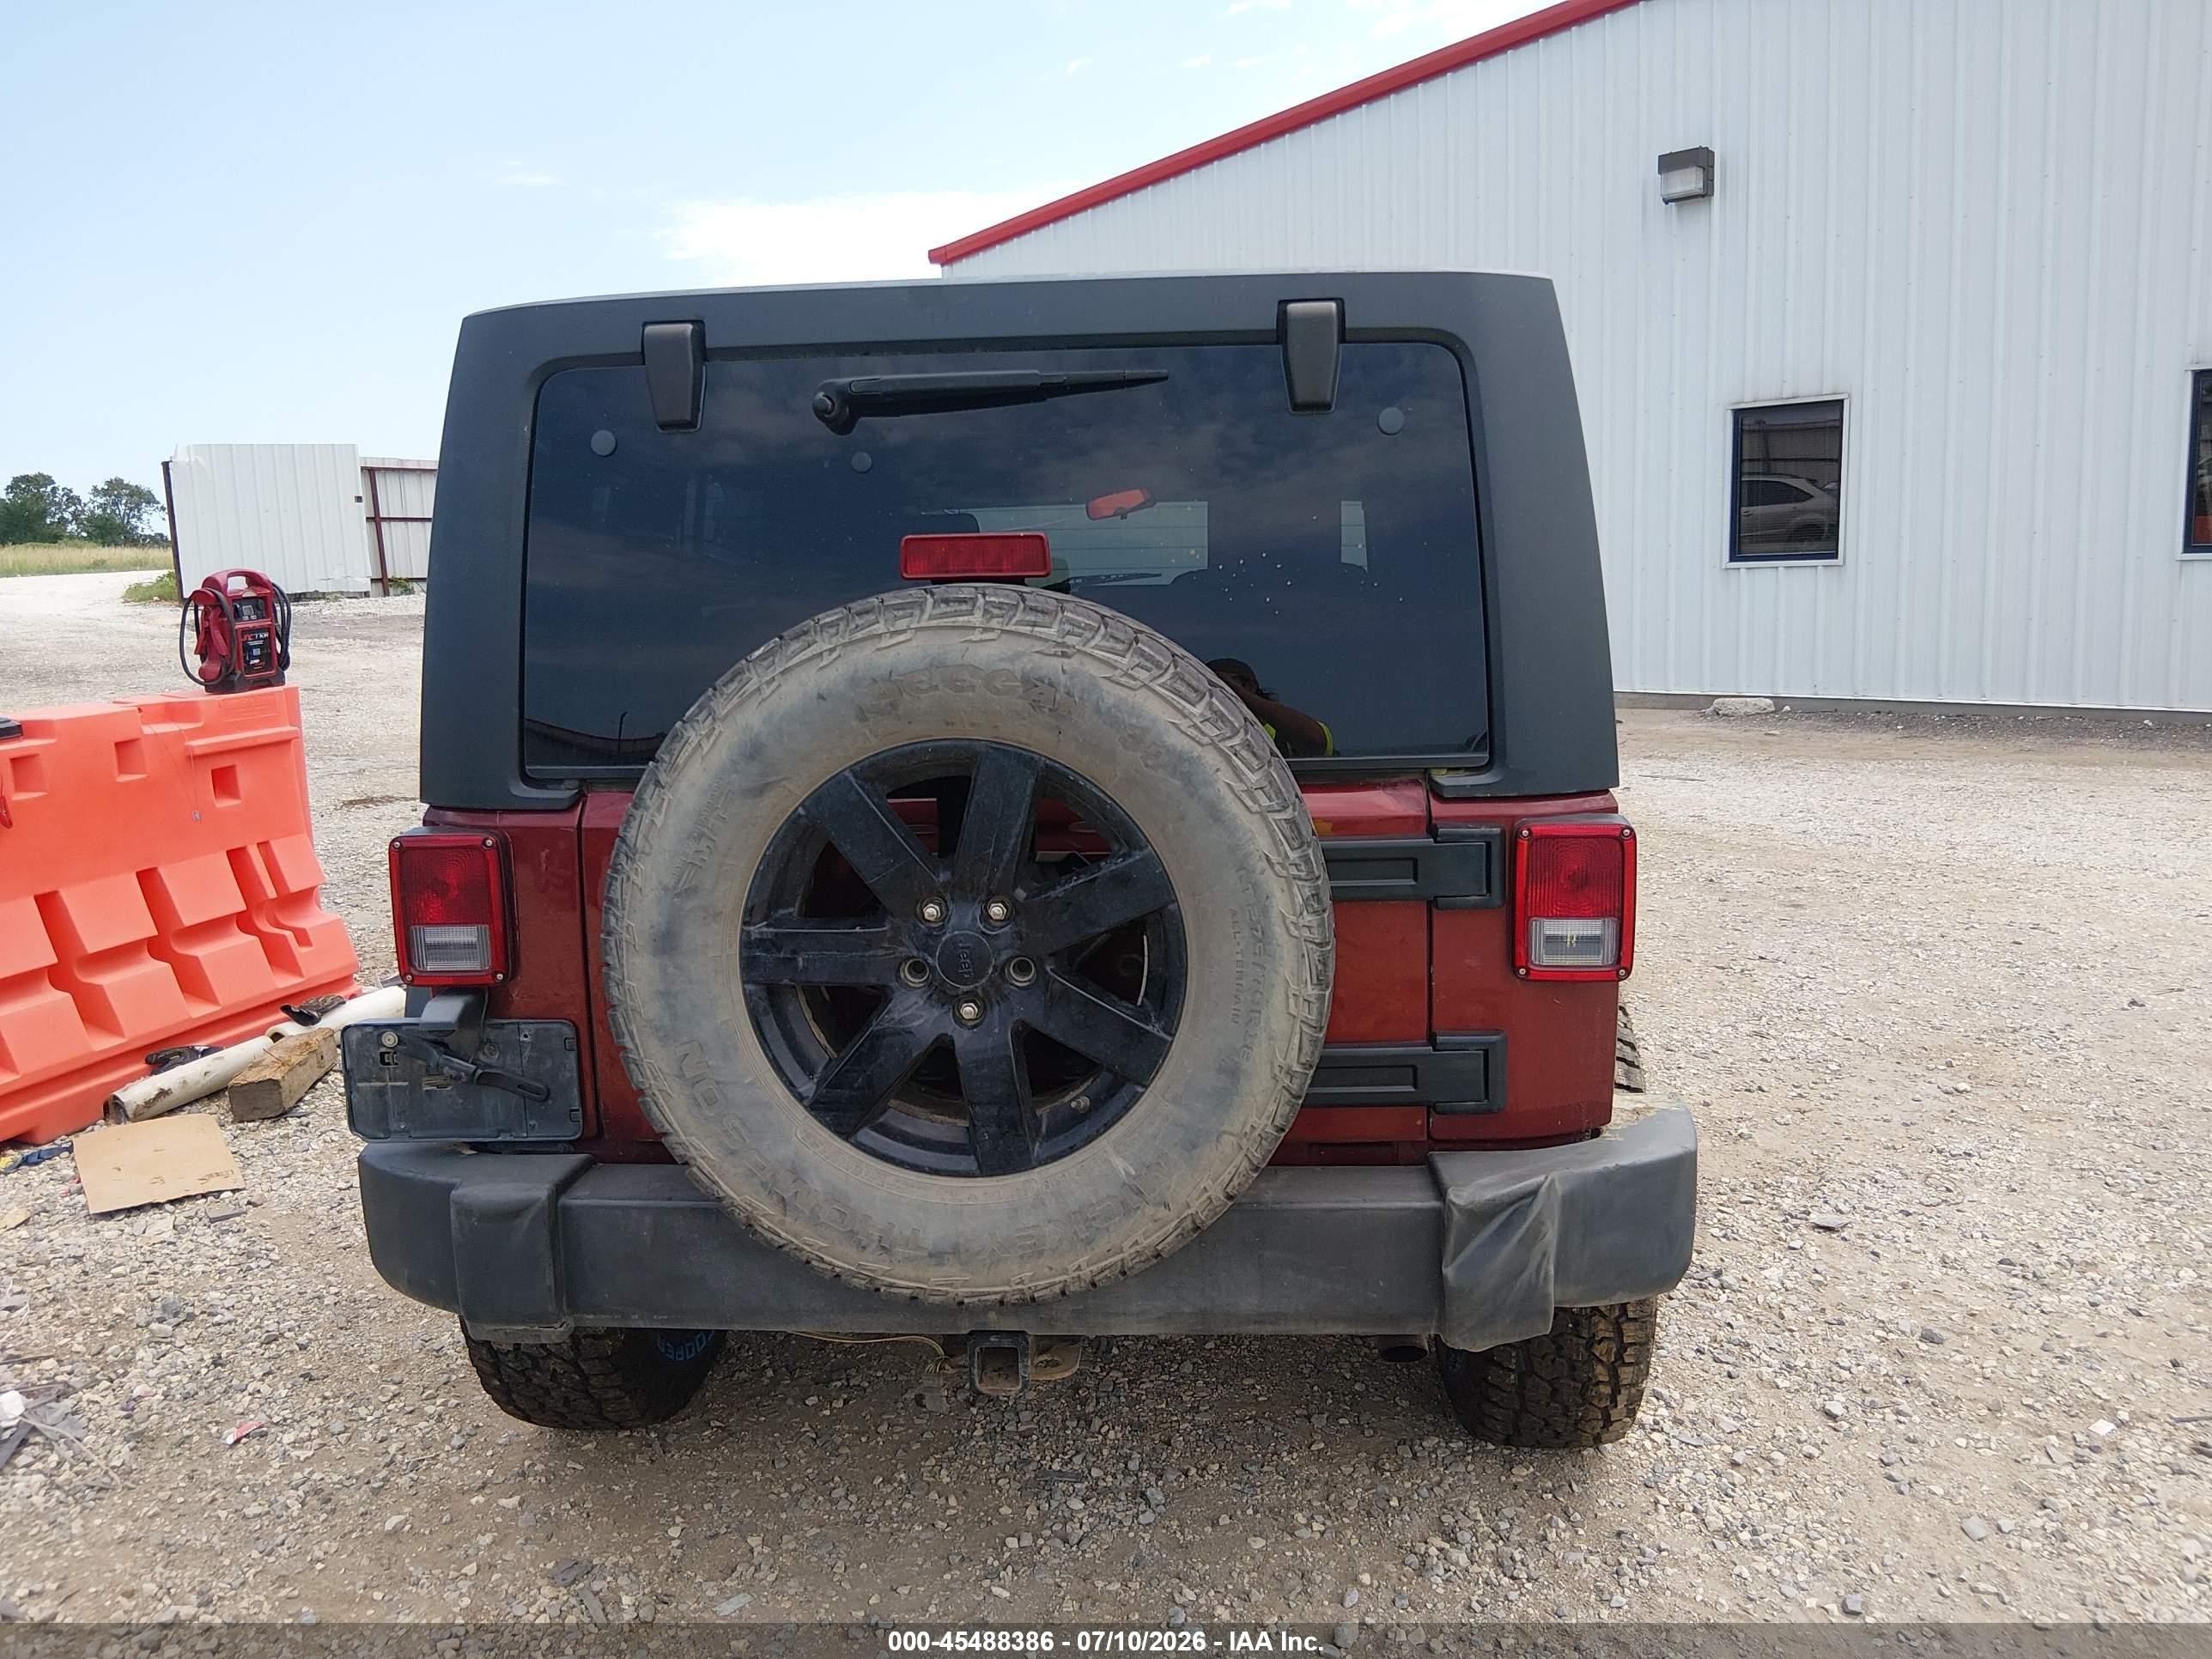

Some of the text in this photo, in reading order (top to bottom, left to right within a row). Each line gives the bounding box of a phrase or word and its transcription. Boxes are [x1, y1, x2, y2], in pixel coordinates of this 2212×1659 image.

[958, 943, 974, 978] Jeep
[1230, 906, 1245, 1025] ALL-TERRAIN
[673, 1036, 930, 1261] THOMPSON
